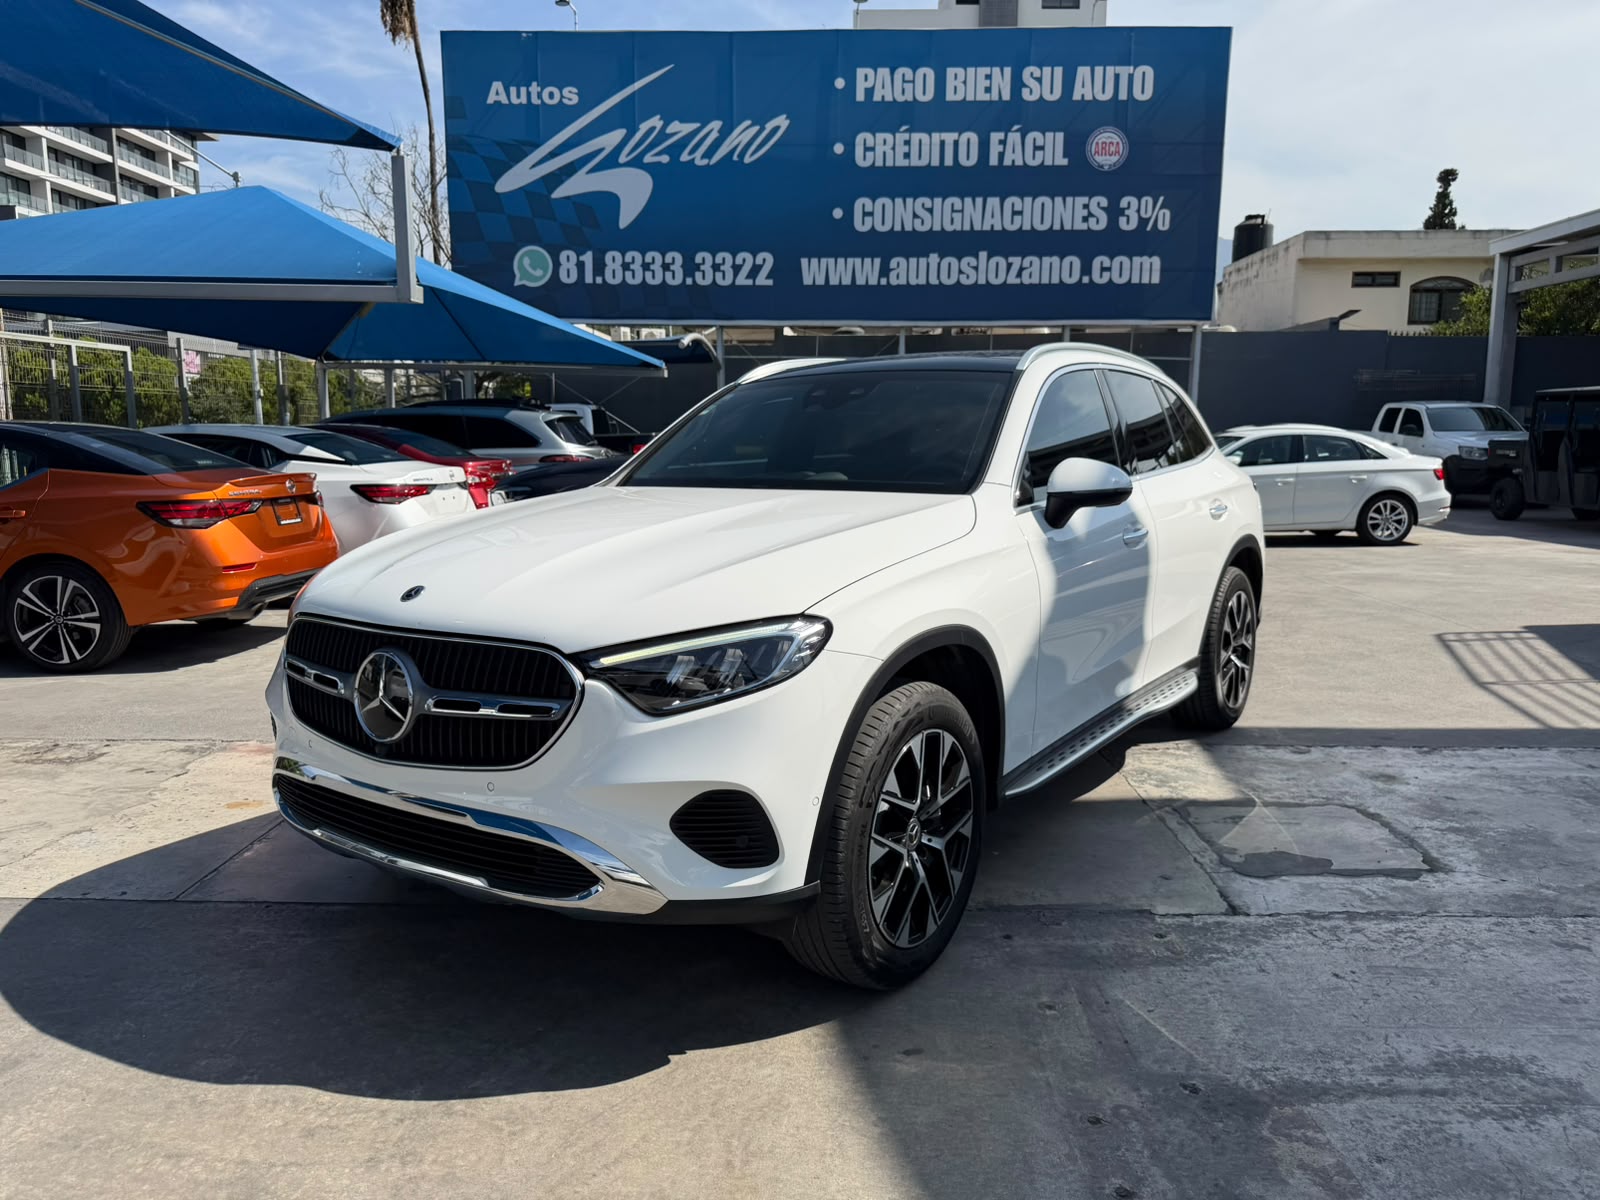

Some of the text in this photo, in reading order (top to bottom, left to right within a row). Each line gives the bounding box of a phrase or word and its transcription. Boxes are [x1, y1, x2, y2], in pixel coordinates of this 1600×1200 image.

[486, 81, 579, 105] Autos
[855, 65, 1154, 102] PAGO BIEN SU AUTO
[494, 65, 790, 229] Lozano
[855, 126, 1069, 167] CRÉDITO FÁCIL
[1094, 141, 1121, 157] ARCA
[854, 196, 1171, 232] CONSIGNACIONES 3%
[559, 250, 774, 286] 81.8333.3322
[801, 251, 1161, 286] www.autoslozano.com
